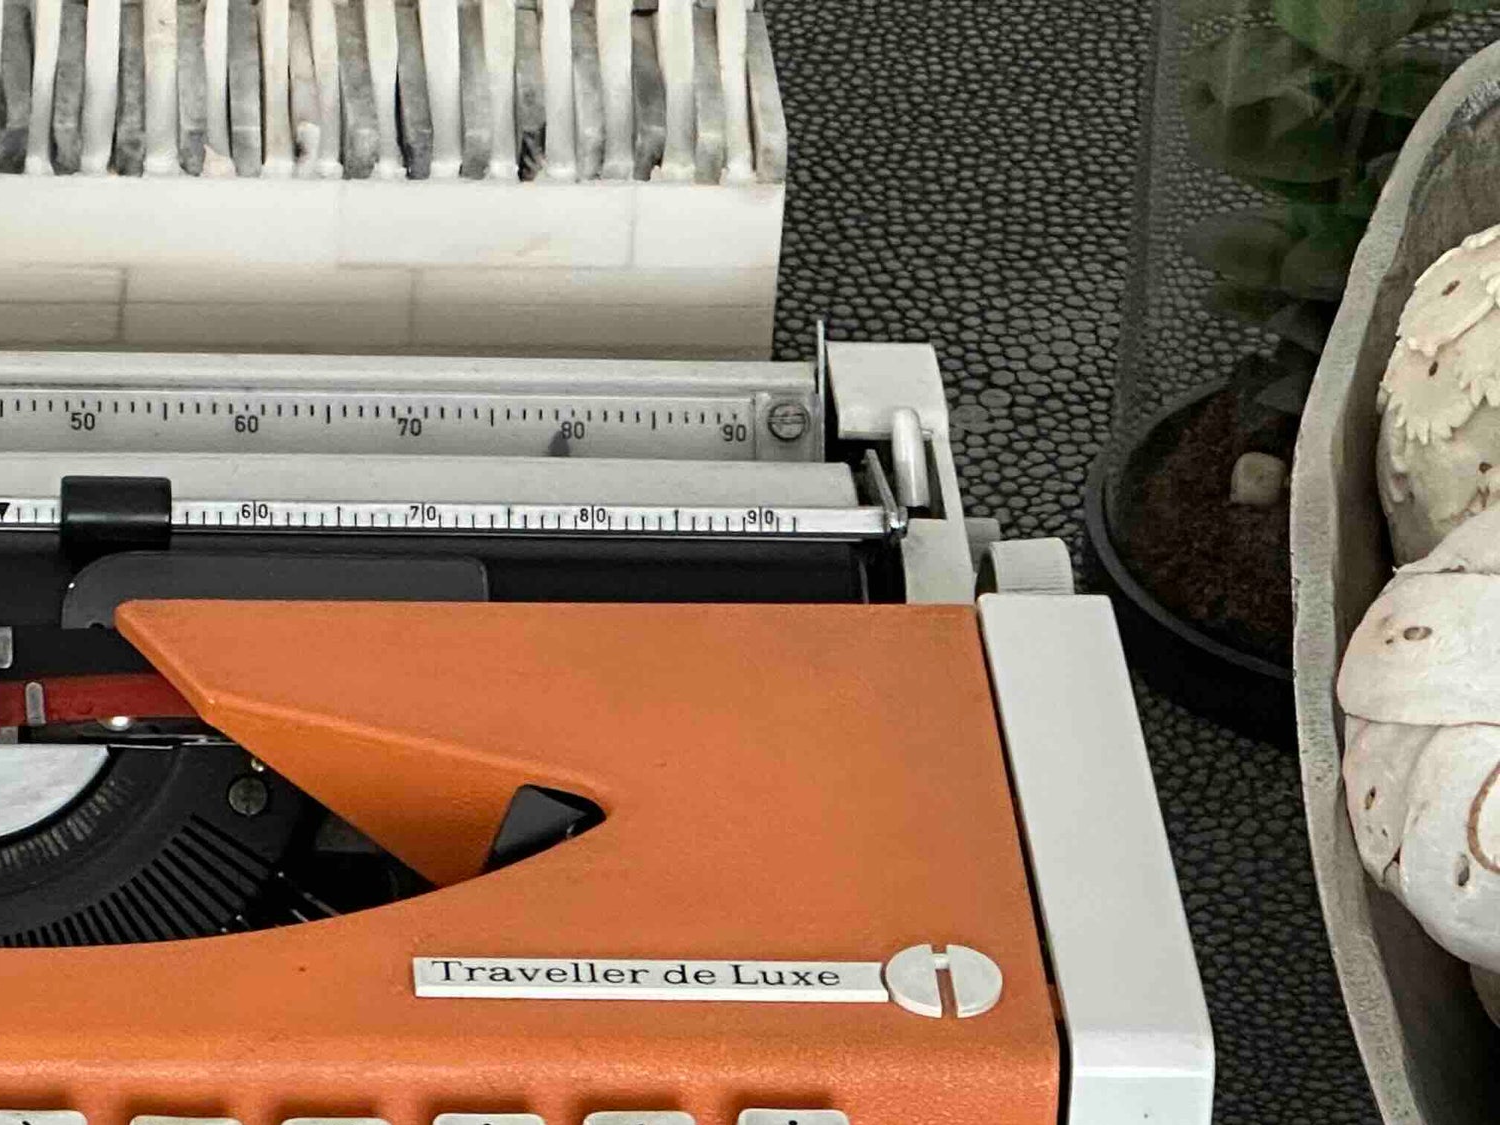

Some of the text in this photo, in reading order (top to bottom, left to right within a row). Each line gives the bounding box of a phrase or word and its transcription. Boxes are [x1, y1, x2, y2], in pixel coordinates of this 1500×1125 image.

[71, 412, 95, 431] 50
[235, 415, 258, 433] 60
[398, 418, 422, 436] 70
[561, 421, 585, 439] 80
[723, 424, 746, 442] 90
[432, 960, 839, 986] Traveller de Luxe
